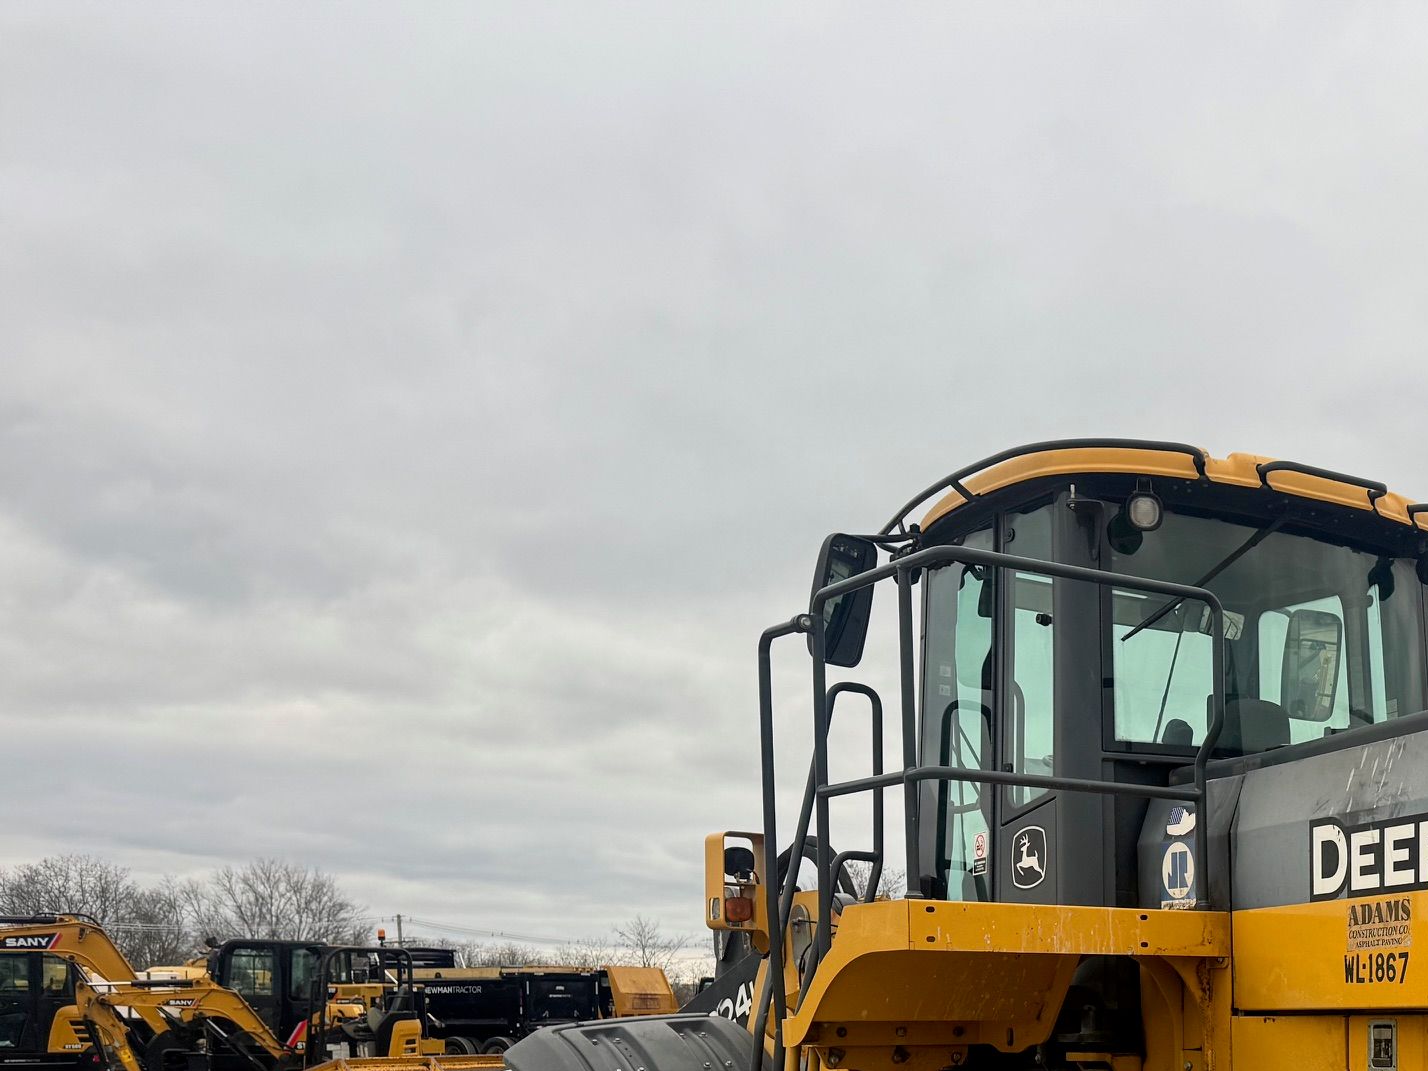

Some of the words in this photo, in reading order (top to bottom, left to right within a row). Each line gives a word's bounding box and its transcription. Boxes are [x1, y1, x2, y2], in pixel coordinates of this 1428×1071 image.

[1348, 898, 1411, 926] ADAMS
[1348, 926, 1398, 939] CONSTRUCTION
[5, 937, 49, 947] SANY
[1356, 939, 1380, 948] ASPHALT
